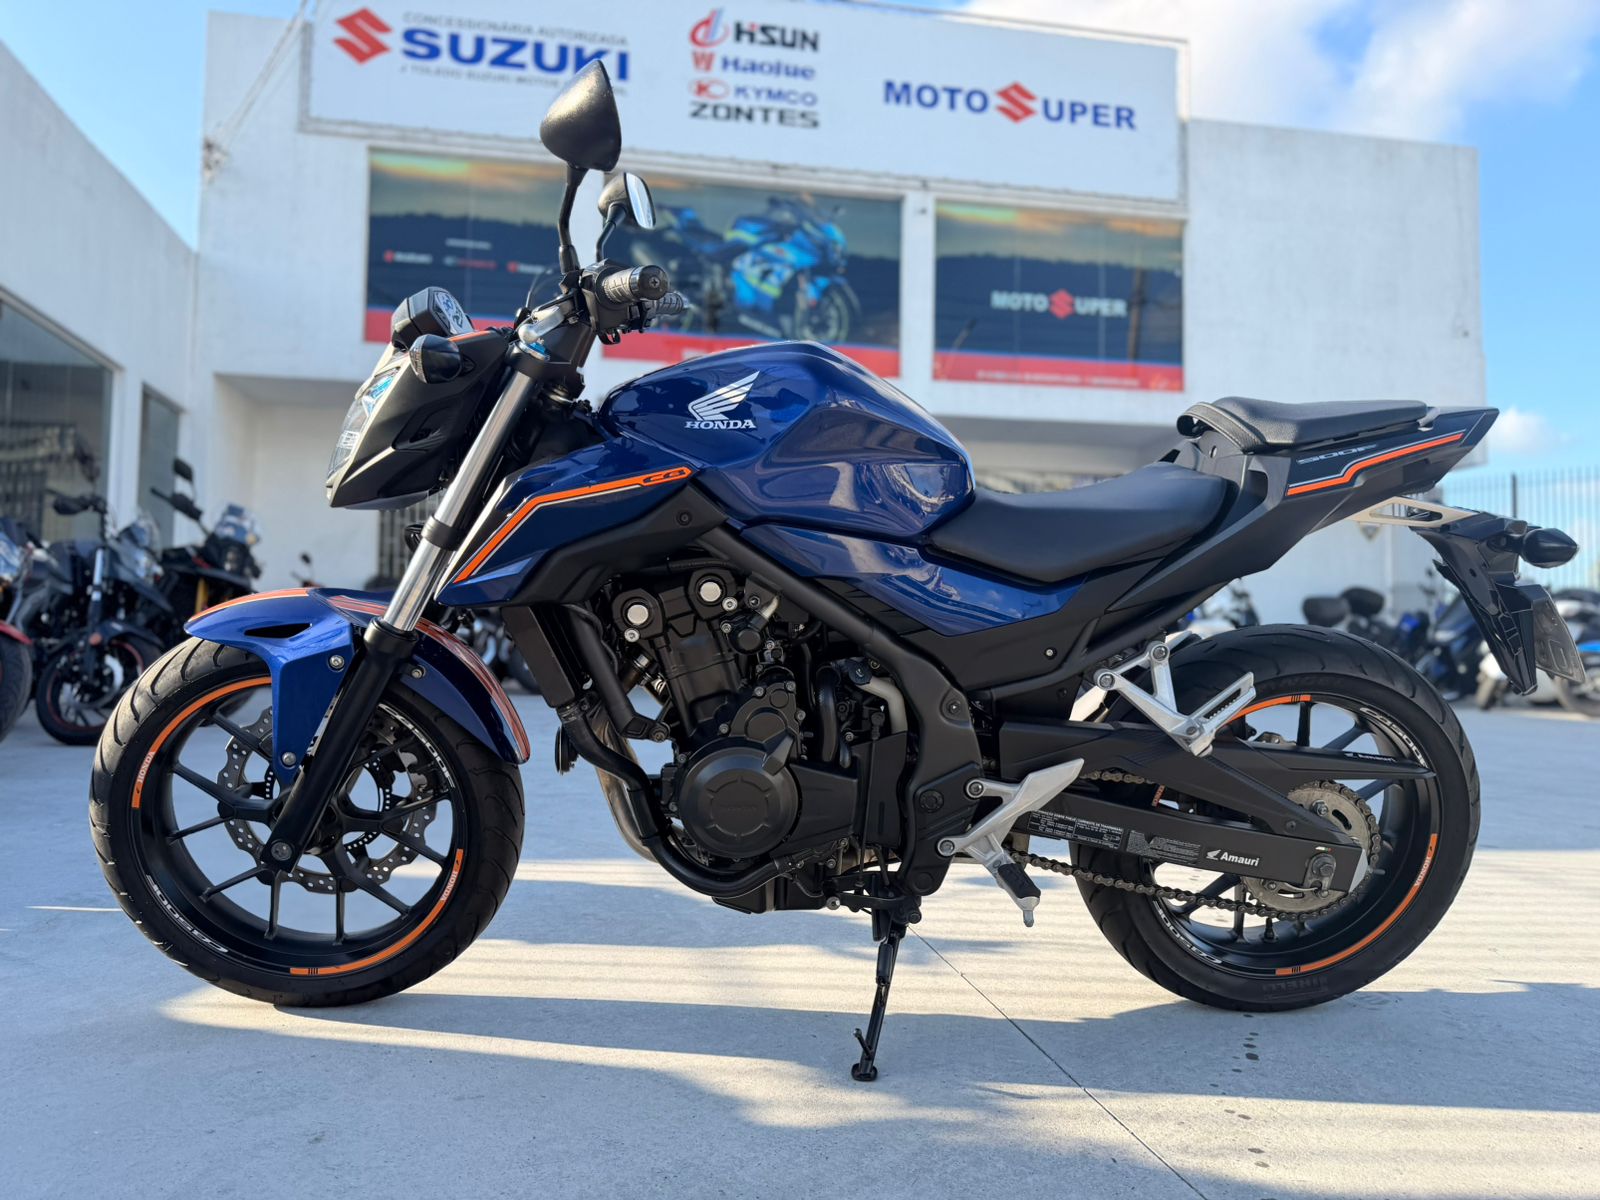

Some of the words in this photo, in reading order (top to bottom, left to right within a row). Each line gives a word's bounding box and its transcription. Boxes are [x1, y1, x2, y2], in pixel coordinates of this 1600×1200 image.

[401, 27, 630, 82] SUZUKI
[734, 85, 818, 107] KYMCO
[689, 101, 820, 129] ZONTES
[684, 419, 757, 430] HONDA
[135, 751, 156, 784] HONDA
[1220, 851, 1261, 867] Amauri
[439, 870, 459, 902] HONDA
